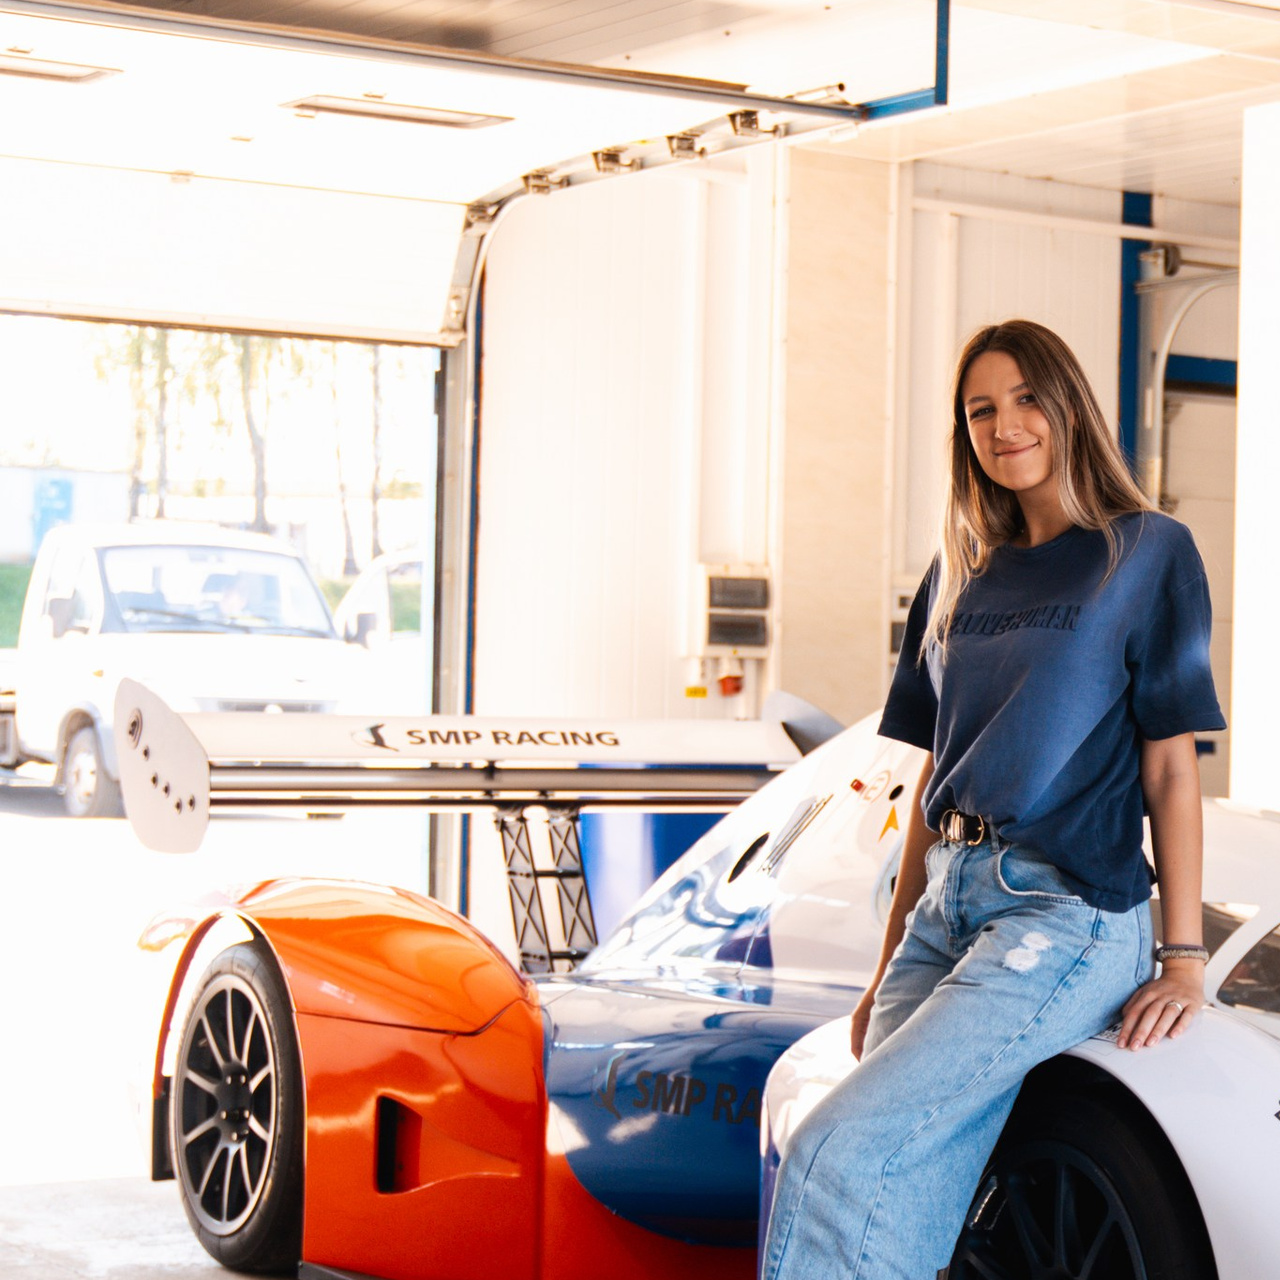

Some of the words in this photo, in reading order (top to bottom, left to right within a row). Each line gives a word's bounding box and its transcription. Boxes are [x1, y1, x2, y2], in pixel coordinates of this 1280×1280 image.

[406, 729, 481, 746] SMP
[491, 730, 620, 747] RACING
[632, 1070, 707, 1116] SMP
[712, 1083, 762, 1128] RA
